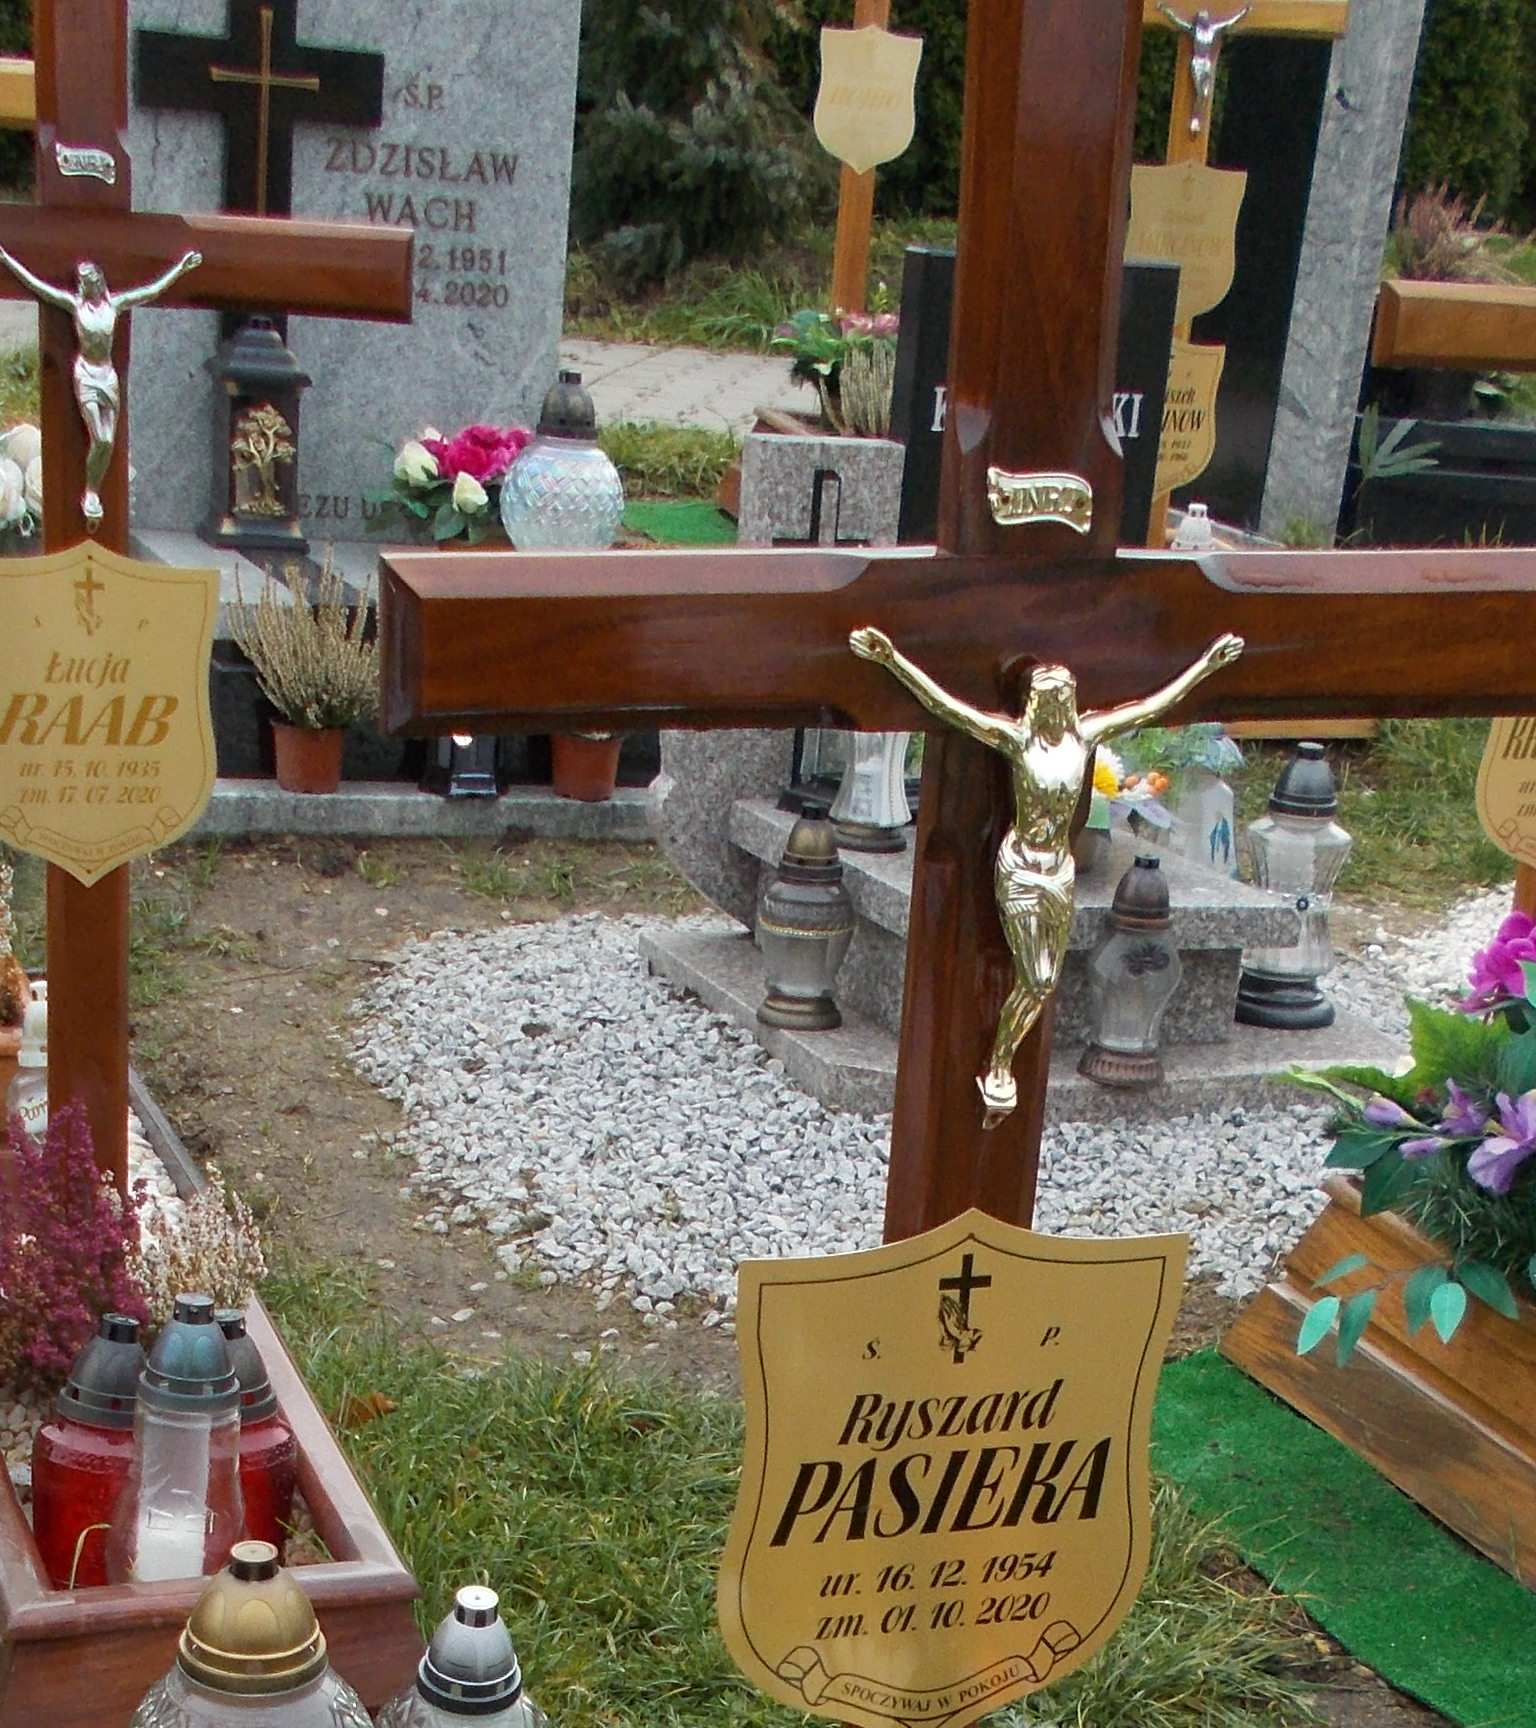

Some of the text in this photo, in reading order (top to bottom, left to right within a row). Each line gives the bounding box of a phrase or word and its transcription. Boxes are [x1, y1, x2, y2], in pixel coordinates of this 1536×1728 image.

[325, 136, 519, 185] ZDZISŁAW
[364, 192, 477, 232] WACH
[44, 650, 132, 690] Łucja
[19, 761, 44, 778] ur.
[19, 786, 51, 805] zm.
[116, 786, 162, 805] 2020
[1041, 1325, 1061, 1347] P.
[837, 1378, 1064, 1452] Ryszard
[770, 1437, 1112, 1547] PASIEKA
[819, 1550, 1057, 1597] ur. 16. 12. 1954
[814, 1591, 1052, 1640] zm. 01. 10. 2020
[841, 1664, 1020, 1713] SPOCZYWAJ W POKOJU
